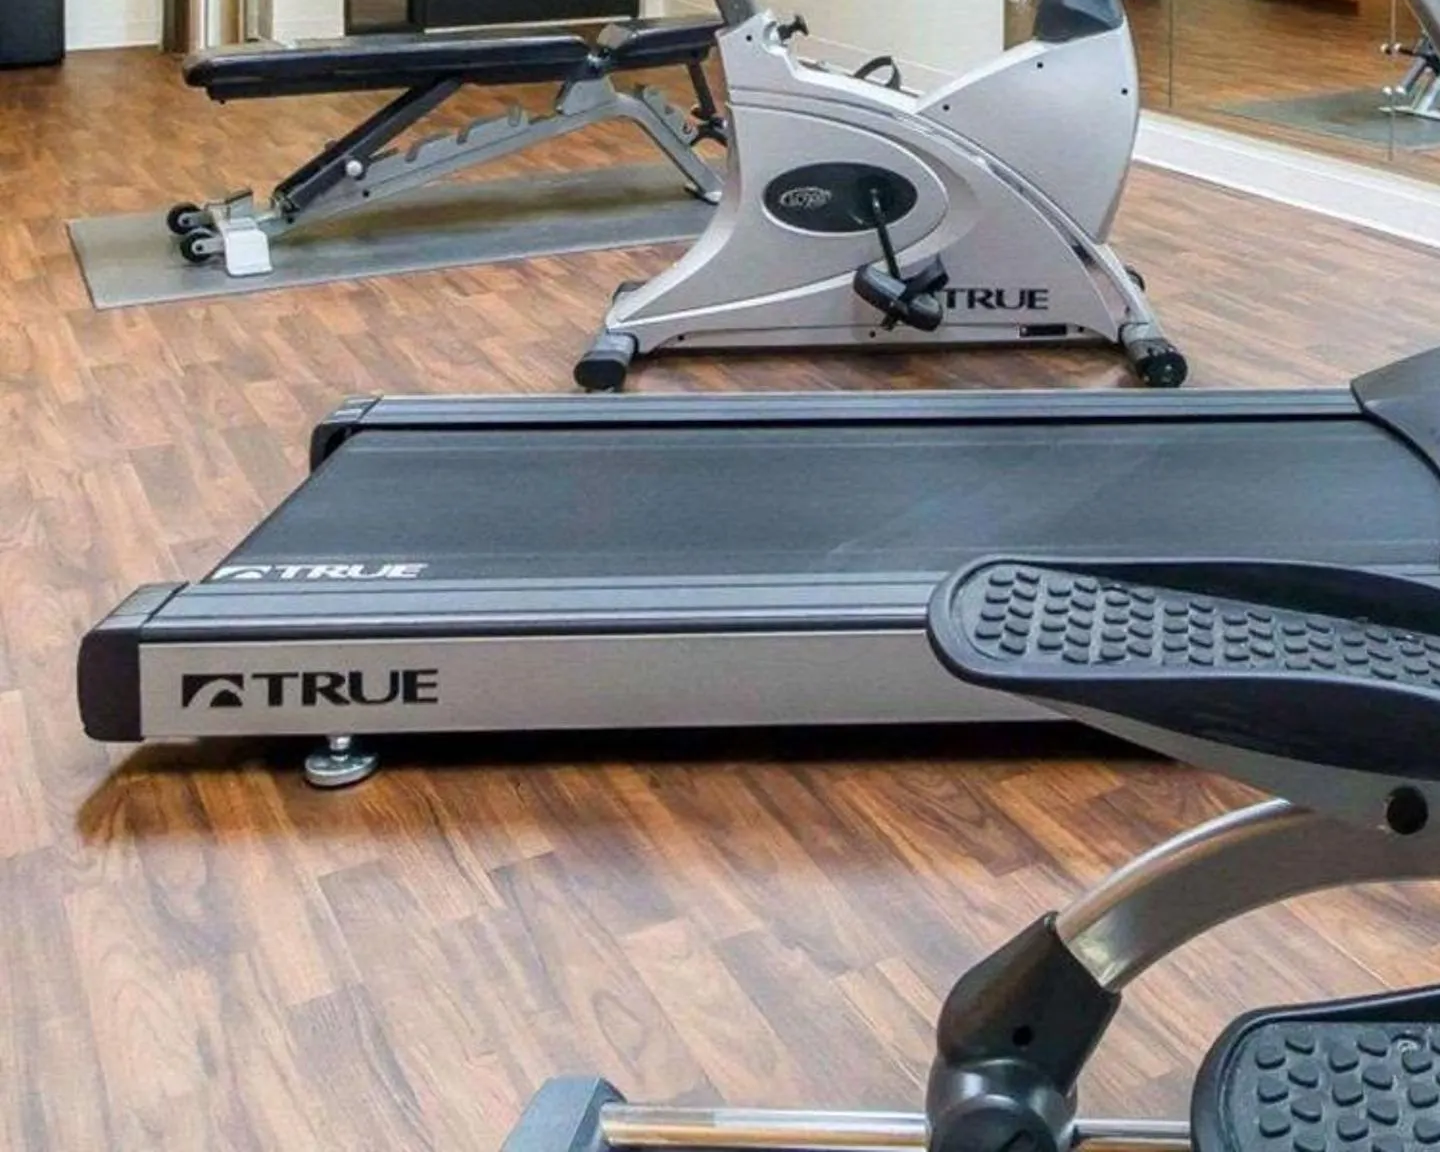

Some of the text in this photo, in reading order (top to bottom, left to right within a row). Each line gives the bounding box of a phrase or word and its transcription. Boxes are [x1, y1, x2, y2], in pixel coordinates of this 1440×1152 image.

[944, 288, 1050, 310] TRUE
[275, 563, 429, 579] TRUE
[251, 668, 439, 708] TRUE
